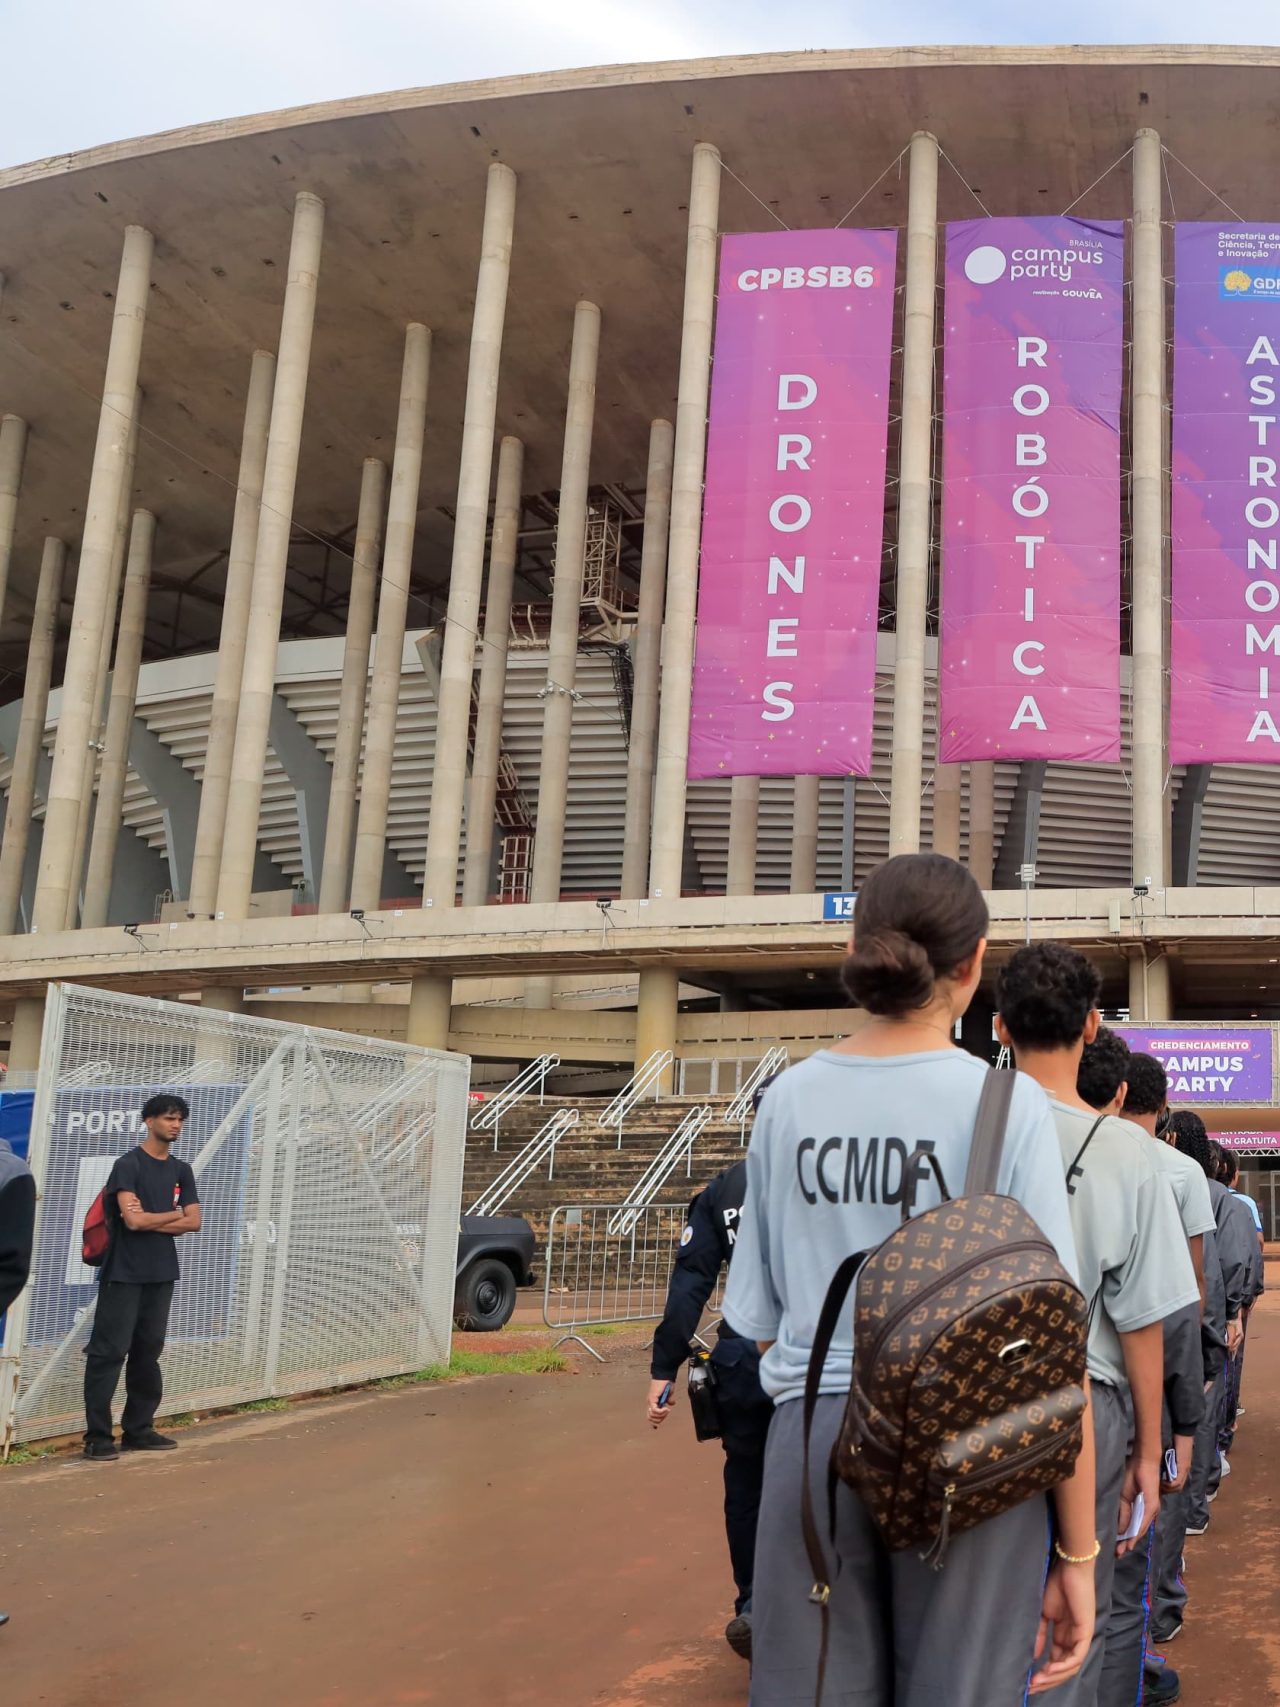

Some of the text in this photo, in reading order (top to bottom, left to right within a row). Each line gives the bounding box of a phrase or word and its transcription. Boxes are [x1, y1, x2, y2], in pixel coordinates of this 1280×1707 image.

[1218, 232, 1280, 241] Secretaria de
[1069, 239, 1103, 249] BRASÍLIA
[1218, 240, 1256, 250] Ciência,
[1011, 249, 1103, 266] campus
[1226, 250, 1269, 259] Inovação
[737, 265, 875, 291] CPBSB6
[1010, 261, 1072, 282] party
[1010, 336, 1049, 731] ROBÓTICA
[761, 373, 818, 722] DRONES
[1150, 1041, 1249, 1050] CREDENCIAMENTO
[1234, 1136, 1277, 1145] GRATUITA
[796, 1136, 936, 1207] CCMDF
